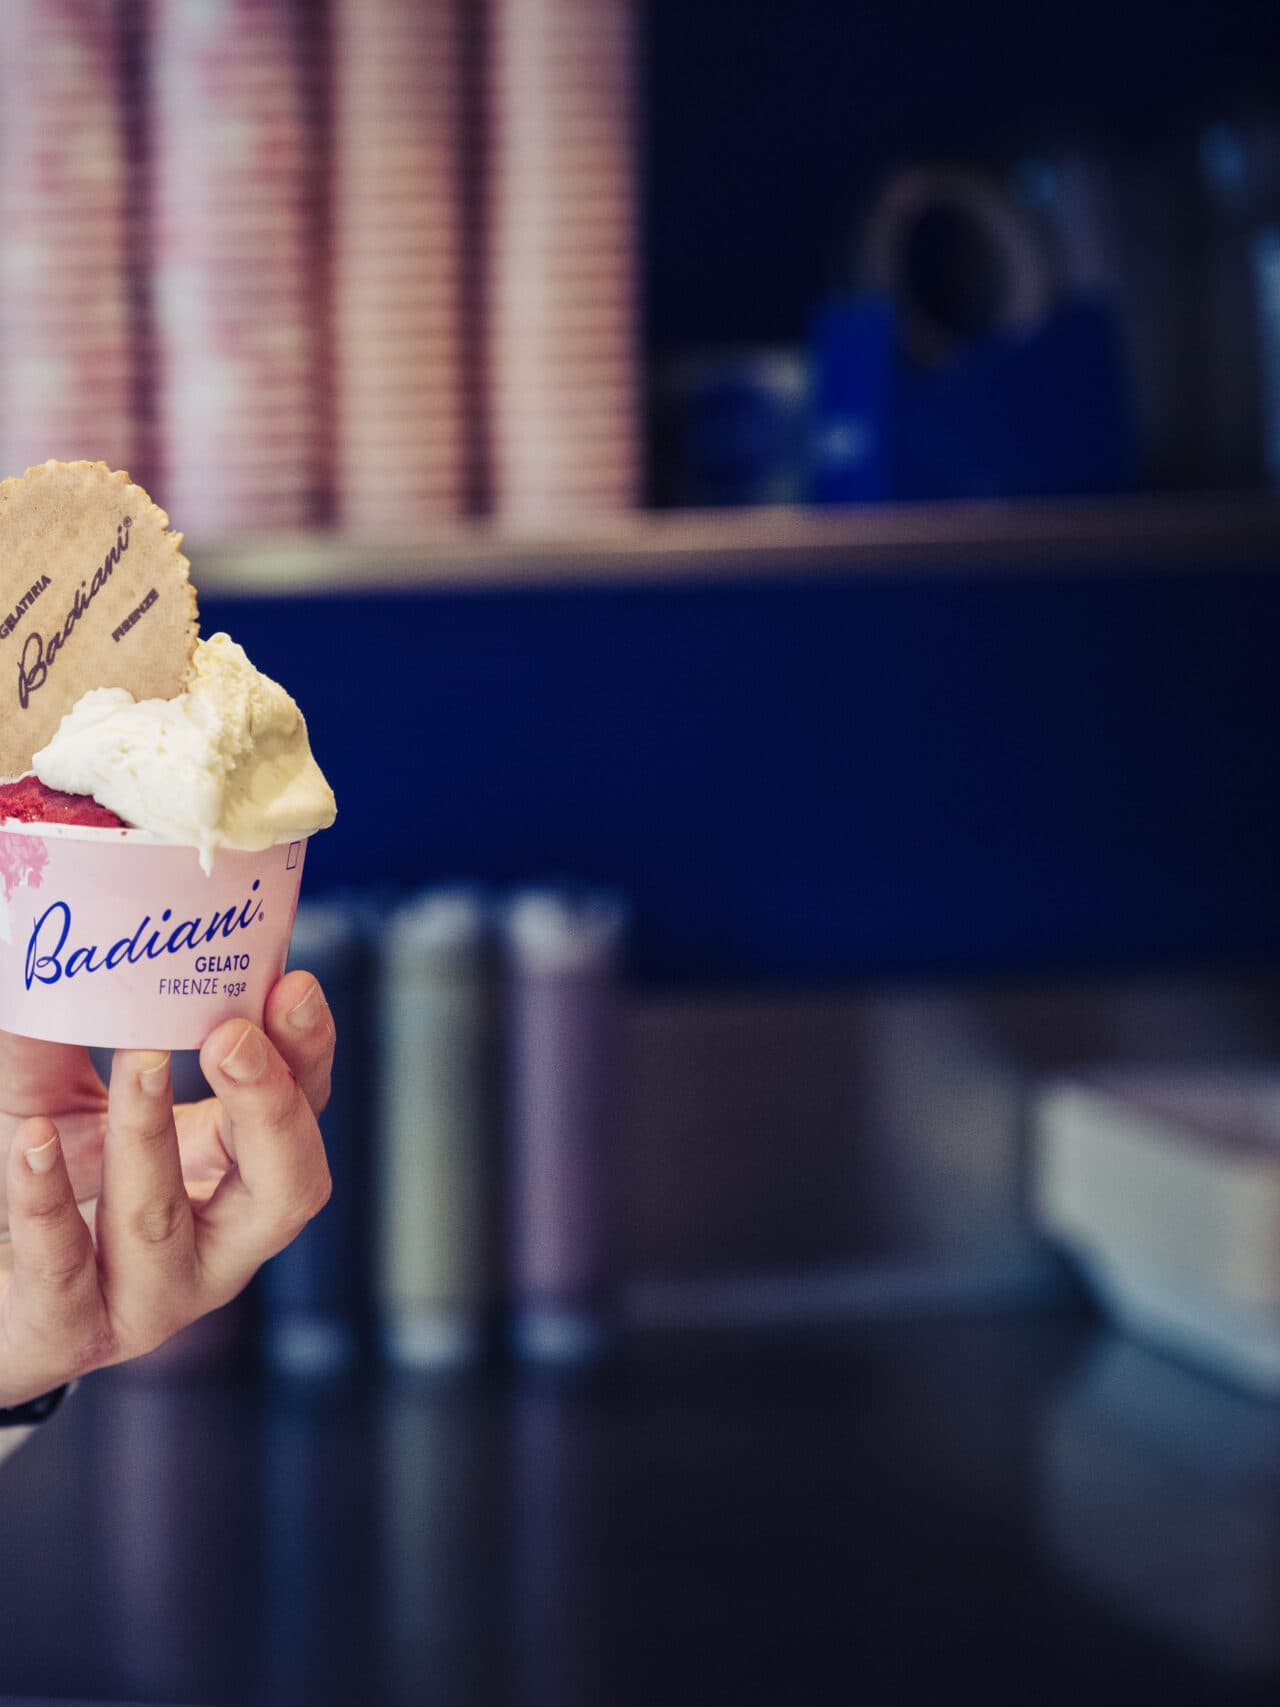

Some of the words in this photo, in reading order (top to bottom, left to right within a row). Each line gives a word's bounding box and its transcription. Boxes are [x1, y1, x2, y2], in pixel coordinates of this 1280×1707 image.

[17, 525, 130, 710] Badiani
[111, 588, 160, 643] FIRENZE
[24, 879, 264, 991] Badiani
[159, 977, 220, 995] FIRENZE
[222, 981, 248, 998] 1932
[195, 953, 250, 973] GELATO
